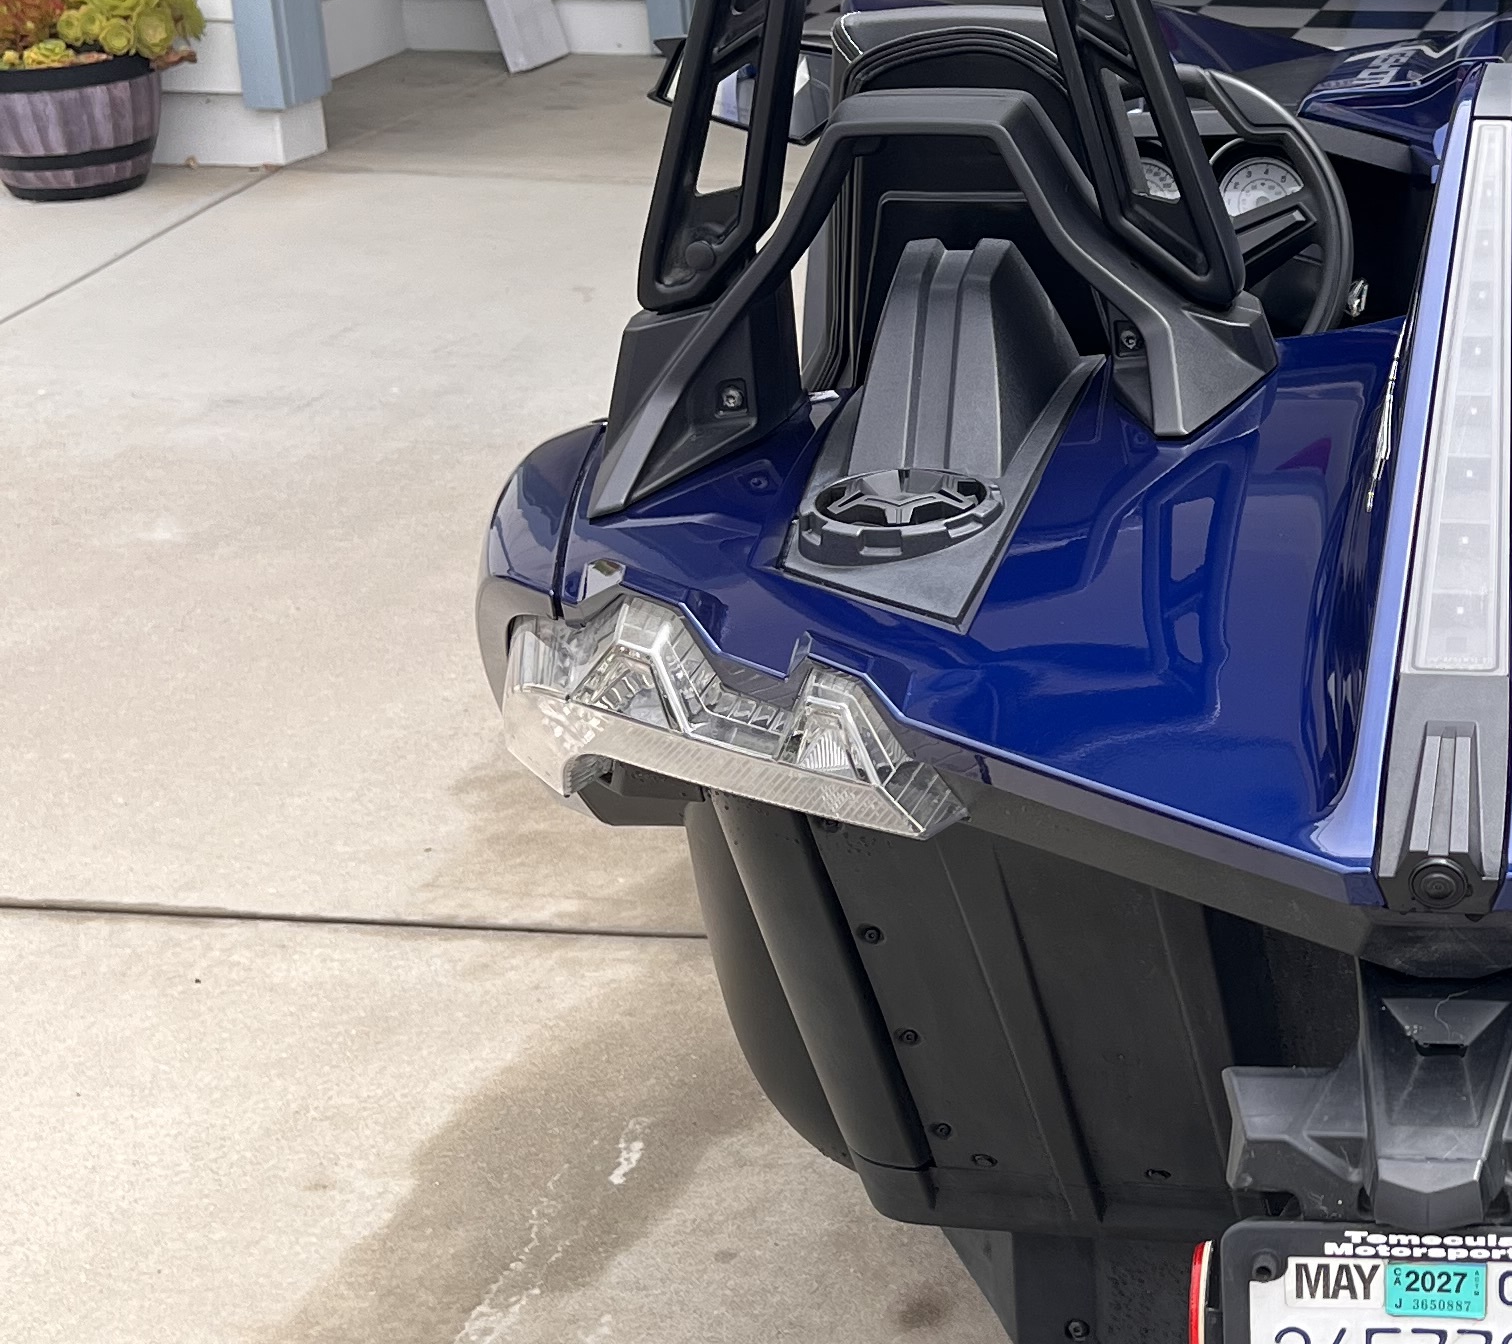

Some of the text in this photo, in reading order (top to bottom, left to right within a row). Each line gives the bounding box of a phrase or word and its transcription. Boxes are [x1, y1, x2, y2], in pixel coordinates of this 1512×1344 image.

[1295, 1263, 1380, 1300] MAY
[1405, 1270, 1468, 1294] 2027
[1395, 1298, 1402, 1309] J
